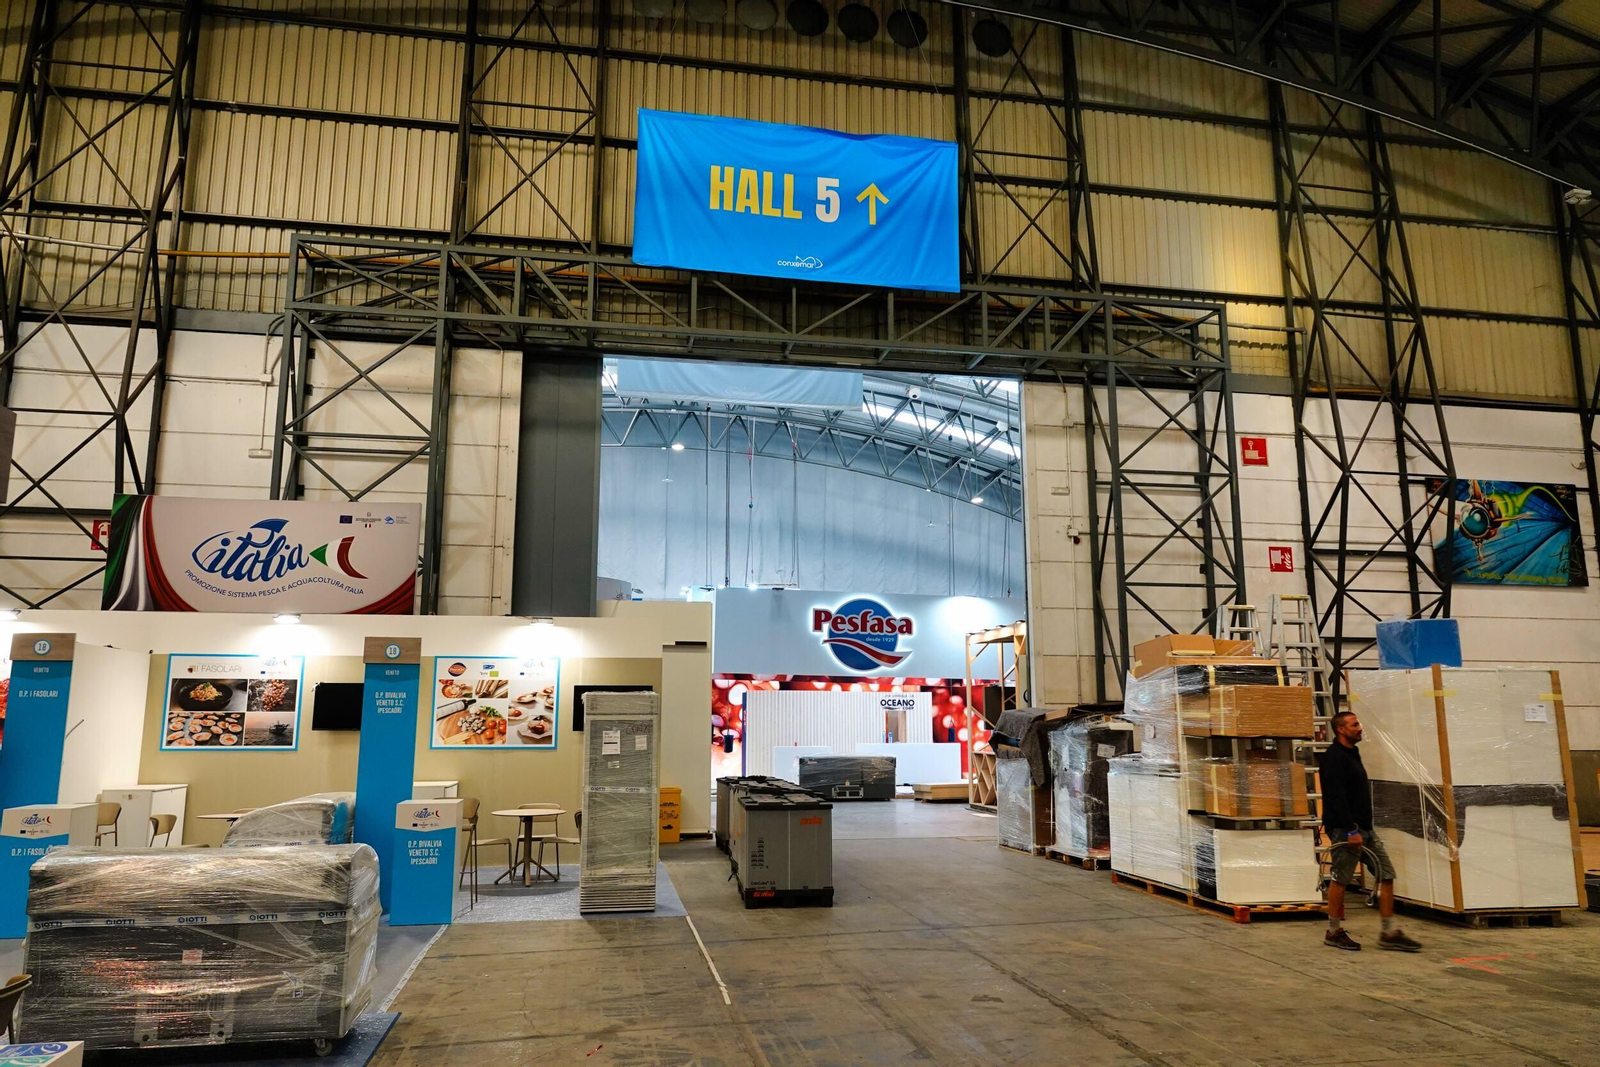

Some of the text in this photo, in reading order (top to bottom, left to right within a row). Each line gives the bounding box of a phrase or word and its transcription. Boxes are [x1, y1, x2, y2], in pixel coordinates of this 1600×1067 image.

[709, 164, 840, 223] HALL 5
[777, 259, 815, 269] conxemar
[192, 518, 310, 582] italia
[184, 569, 365, 599] PROMOZIONE SISTEMA PESCA E ACQUACOLTURA ITALIA
[812, 607, 914, 636] Pesfasa
[38, 643, 46, 651] 18
[200, 664, 243, 673] FASOLARI
[880, 698, 915, 707] OCEANO
[11, 848, 21, 856] O.P.
